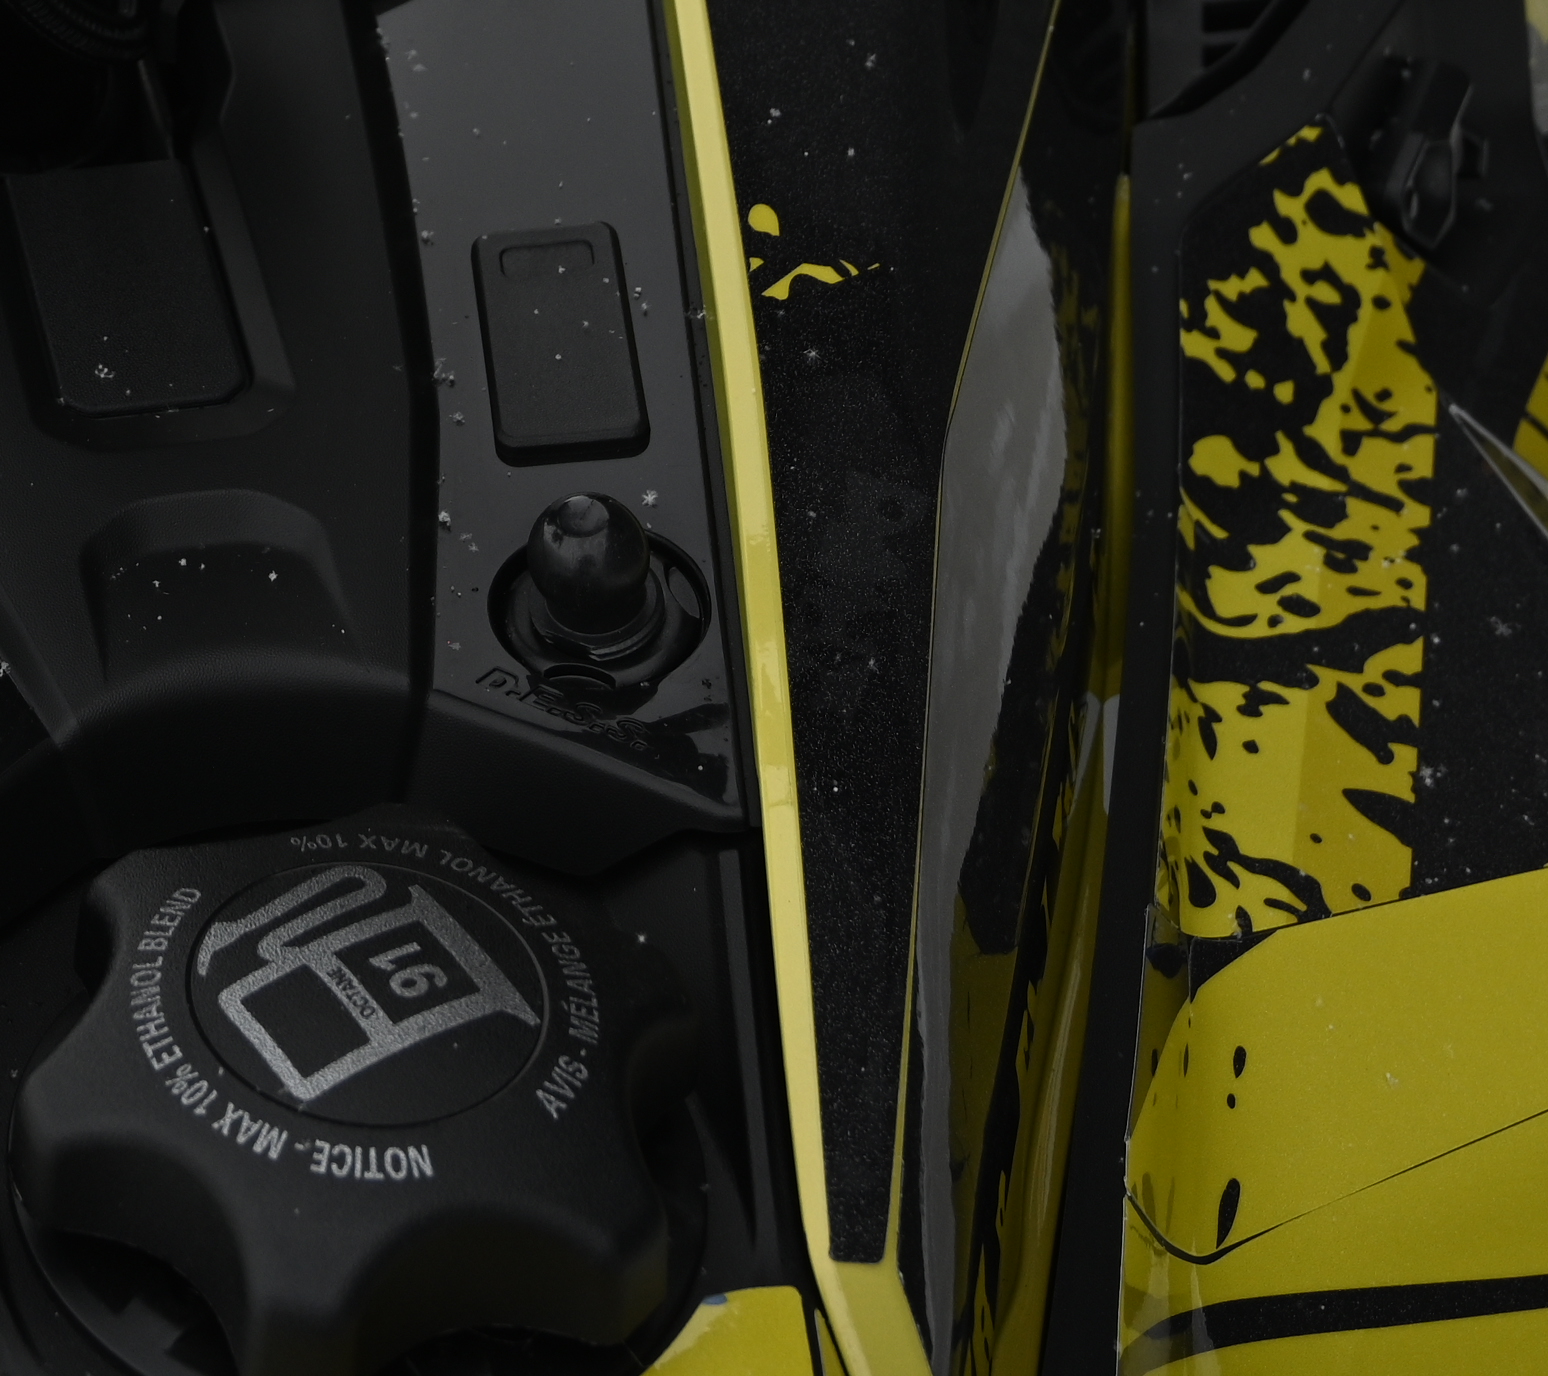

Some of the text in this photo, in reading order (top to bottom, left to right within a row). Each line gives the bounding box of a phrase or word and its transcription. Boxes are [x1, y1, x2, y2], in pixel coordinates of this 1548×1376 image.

[290, 833, 348, 852] 10%
[357, 833, 429, 859] MAX
[137, 887, 202, 950] BLEND
[326, 967, 376, 1019] OCTANE
[368, 941, 448, 998] 91
[541, 931, 600, 1045] MÉLANGE
[130, 955, 183, 1071] ETHANOL
[165, 1063, 219, 1116] 10%
[535, 1054, 589, 1120] AVIS
[211, 1101, 288, 1161] MAX
[309, 1138, 434, 1181] NOTICE
